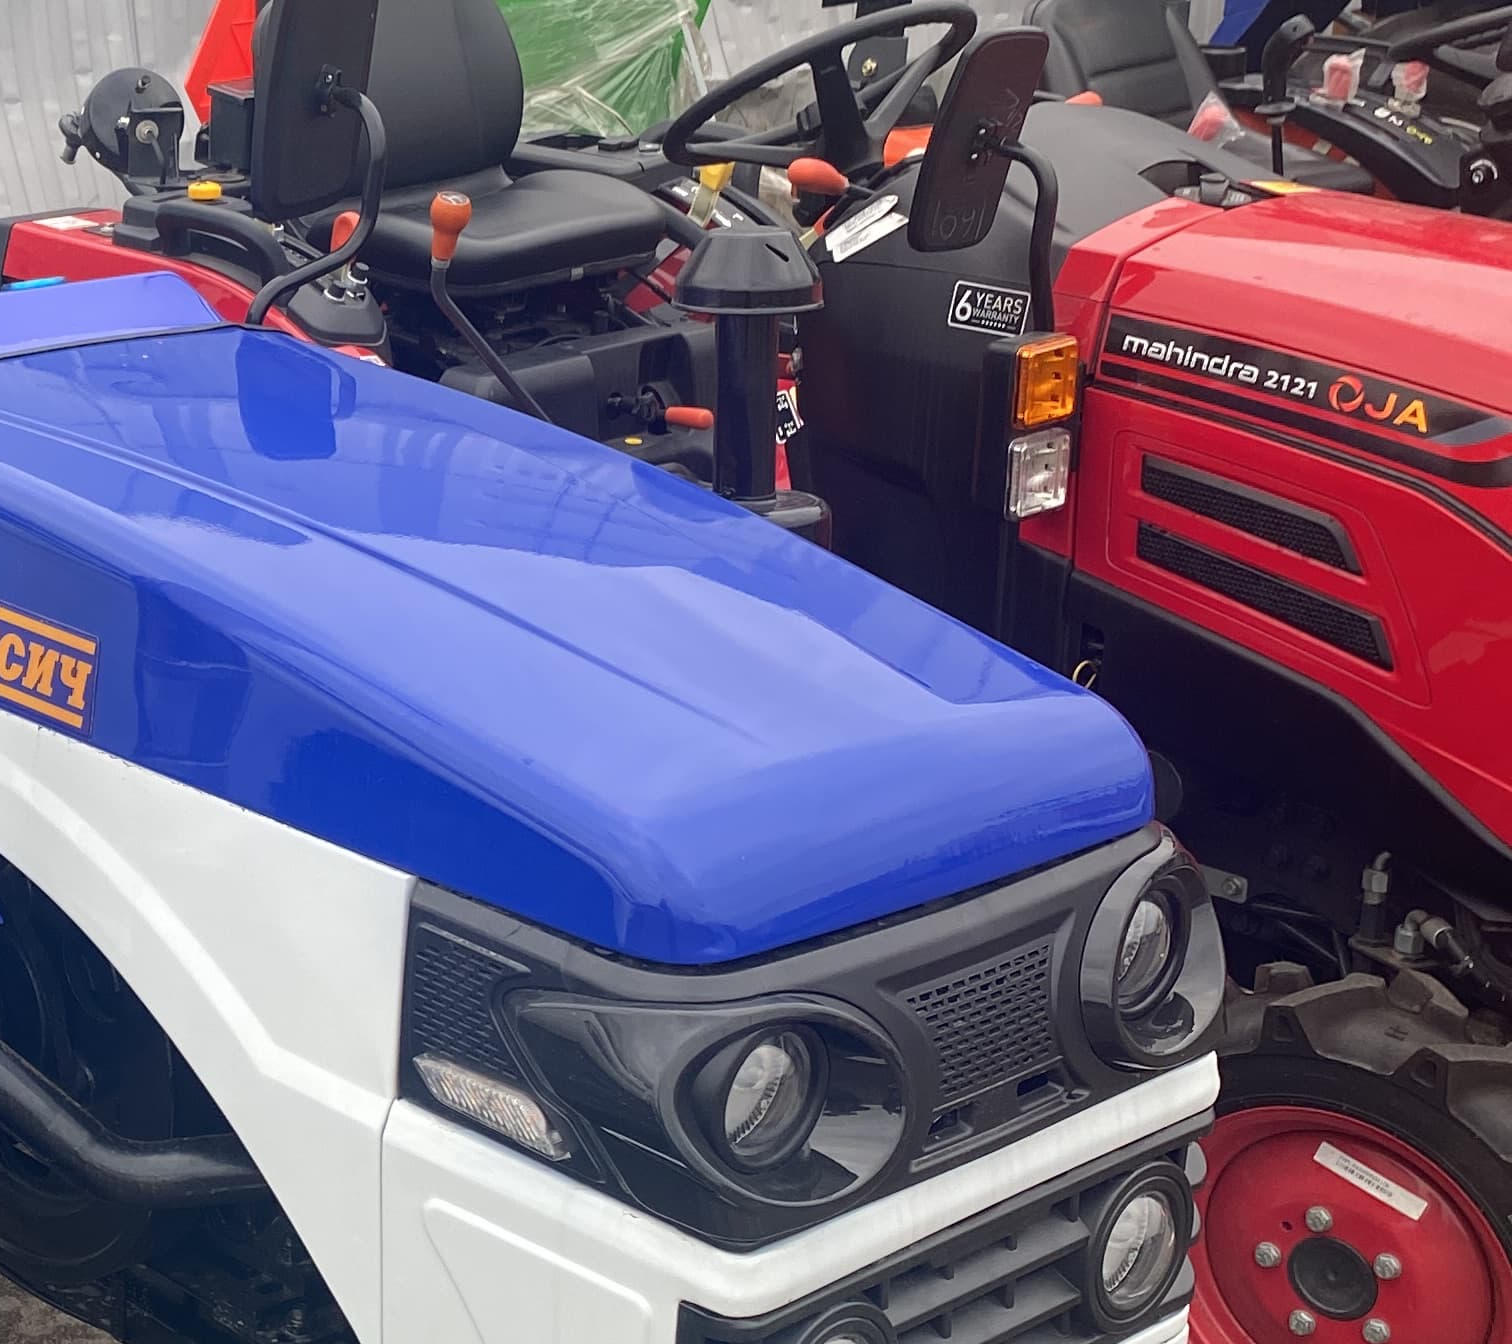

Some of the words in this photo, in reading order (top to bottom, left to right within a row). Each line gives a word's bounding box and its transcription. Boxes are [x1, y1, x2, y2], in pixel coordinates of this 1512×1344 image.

[955, 289, 973, 322] 6
[976, 291, 1024, 315] YEARS
[972, 307, 1020, 324] WARRANTY
[1121, 334, 1260, 385] mahindra
[1263, 369, 1319, 400] 2121
